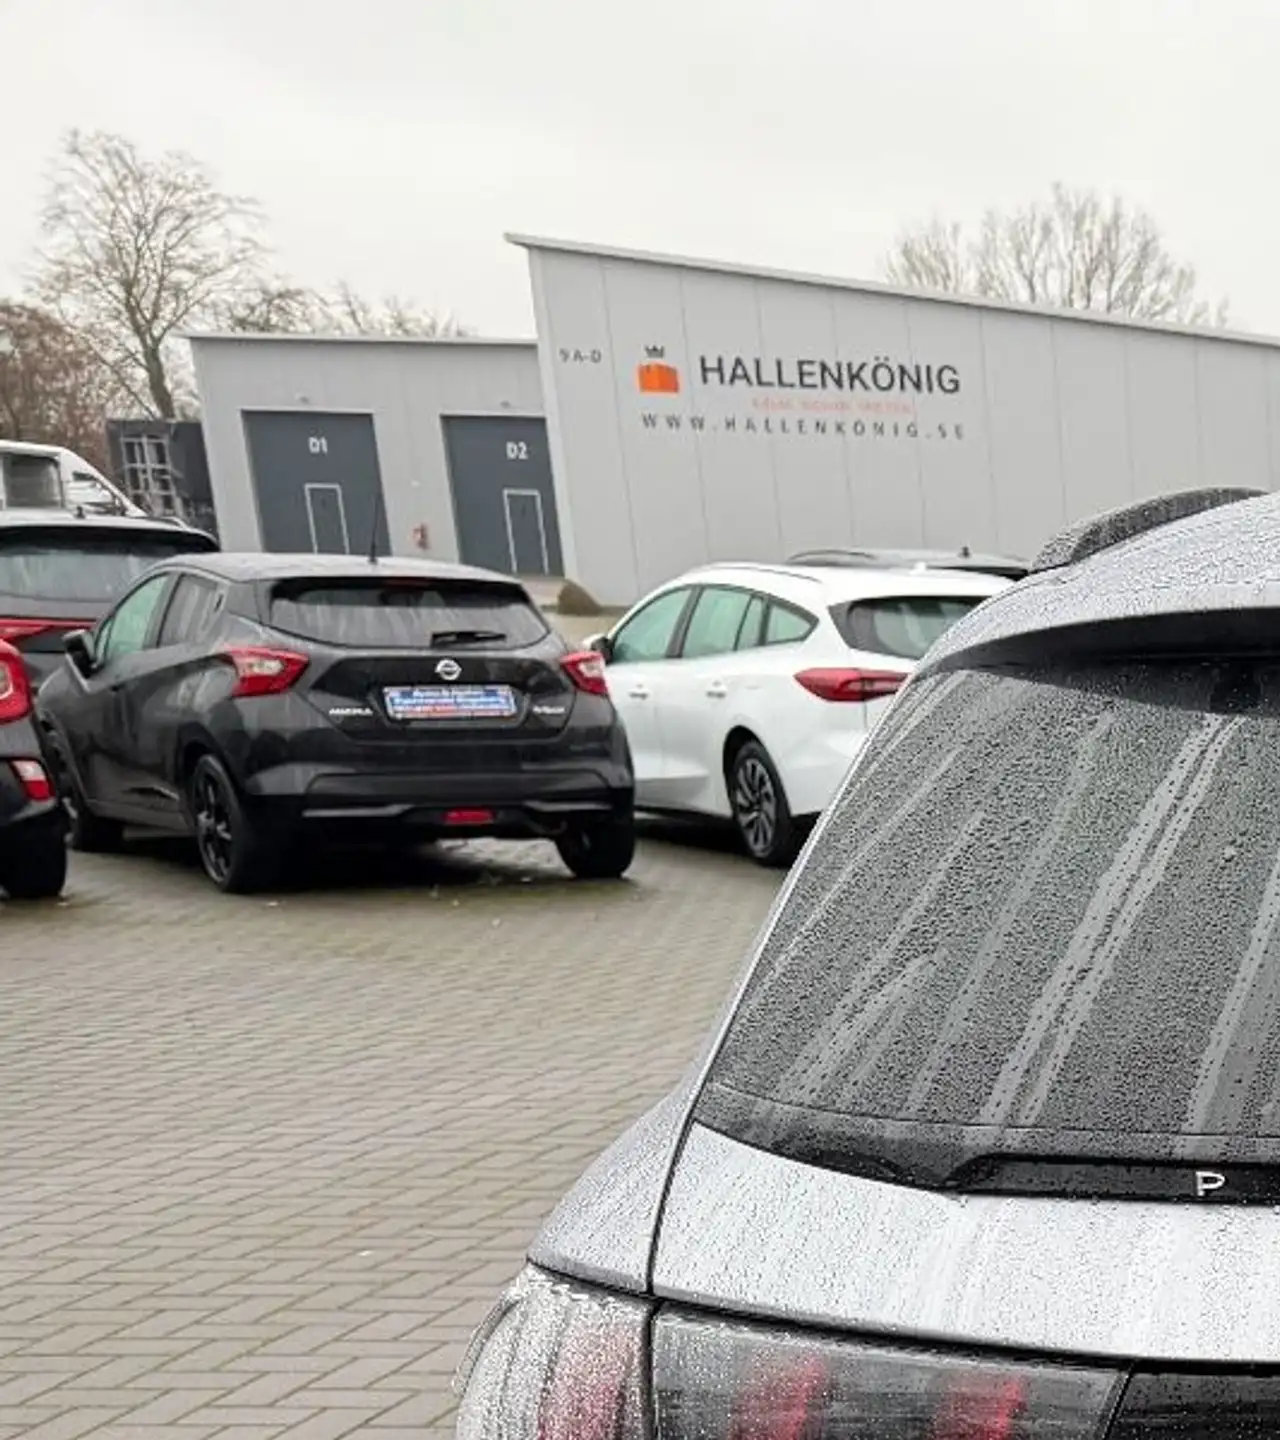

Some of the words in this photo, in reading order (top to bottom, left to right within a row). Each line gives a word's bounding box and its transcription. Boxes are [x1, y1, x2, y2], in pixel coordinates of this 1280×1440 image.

[700, 354, 960, 394] HALLENKÖNIG
[309, 437, 328, 455] D1
[507, 442, 528, 460] D2
